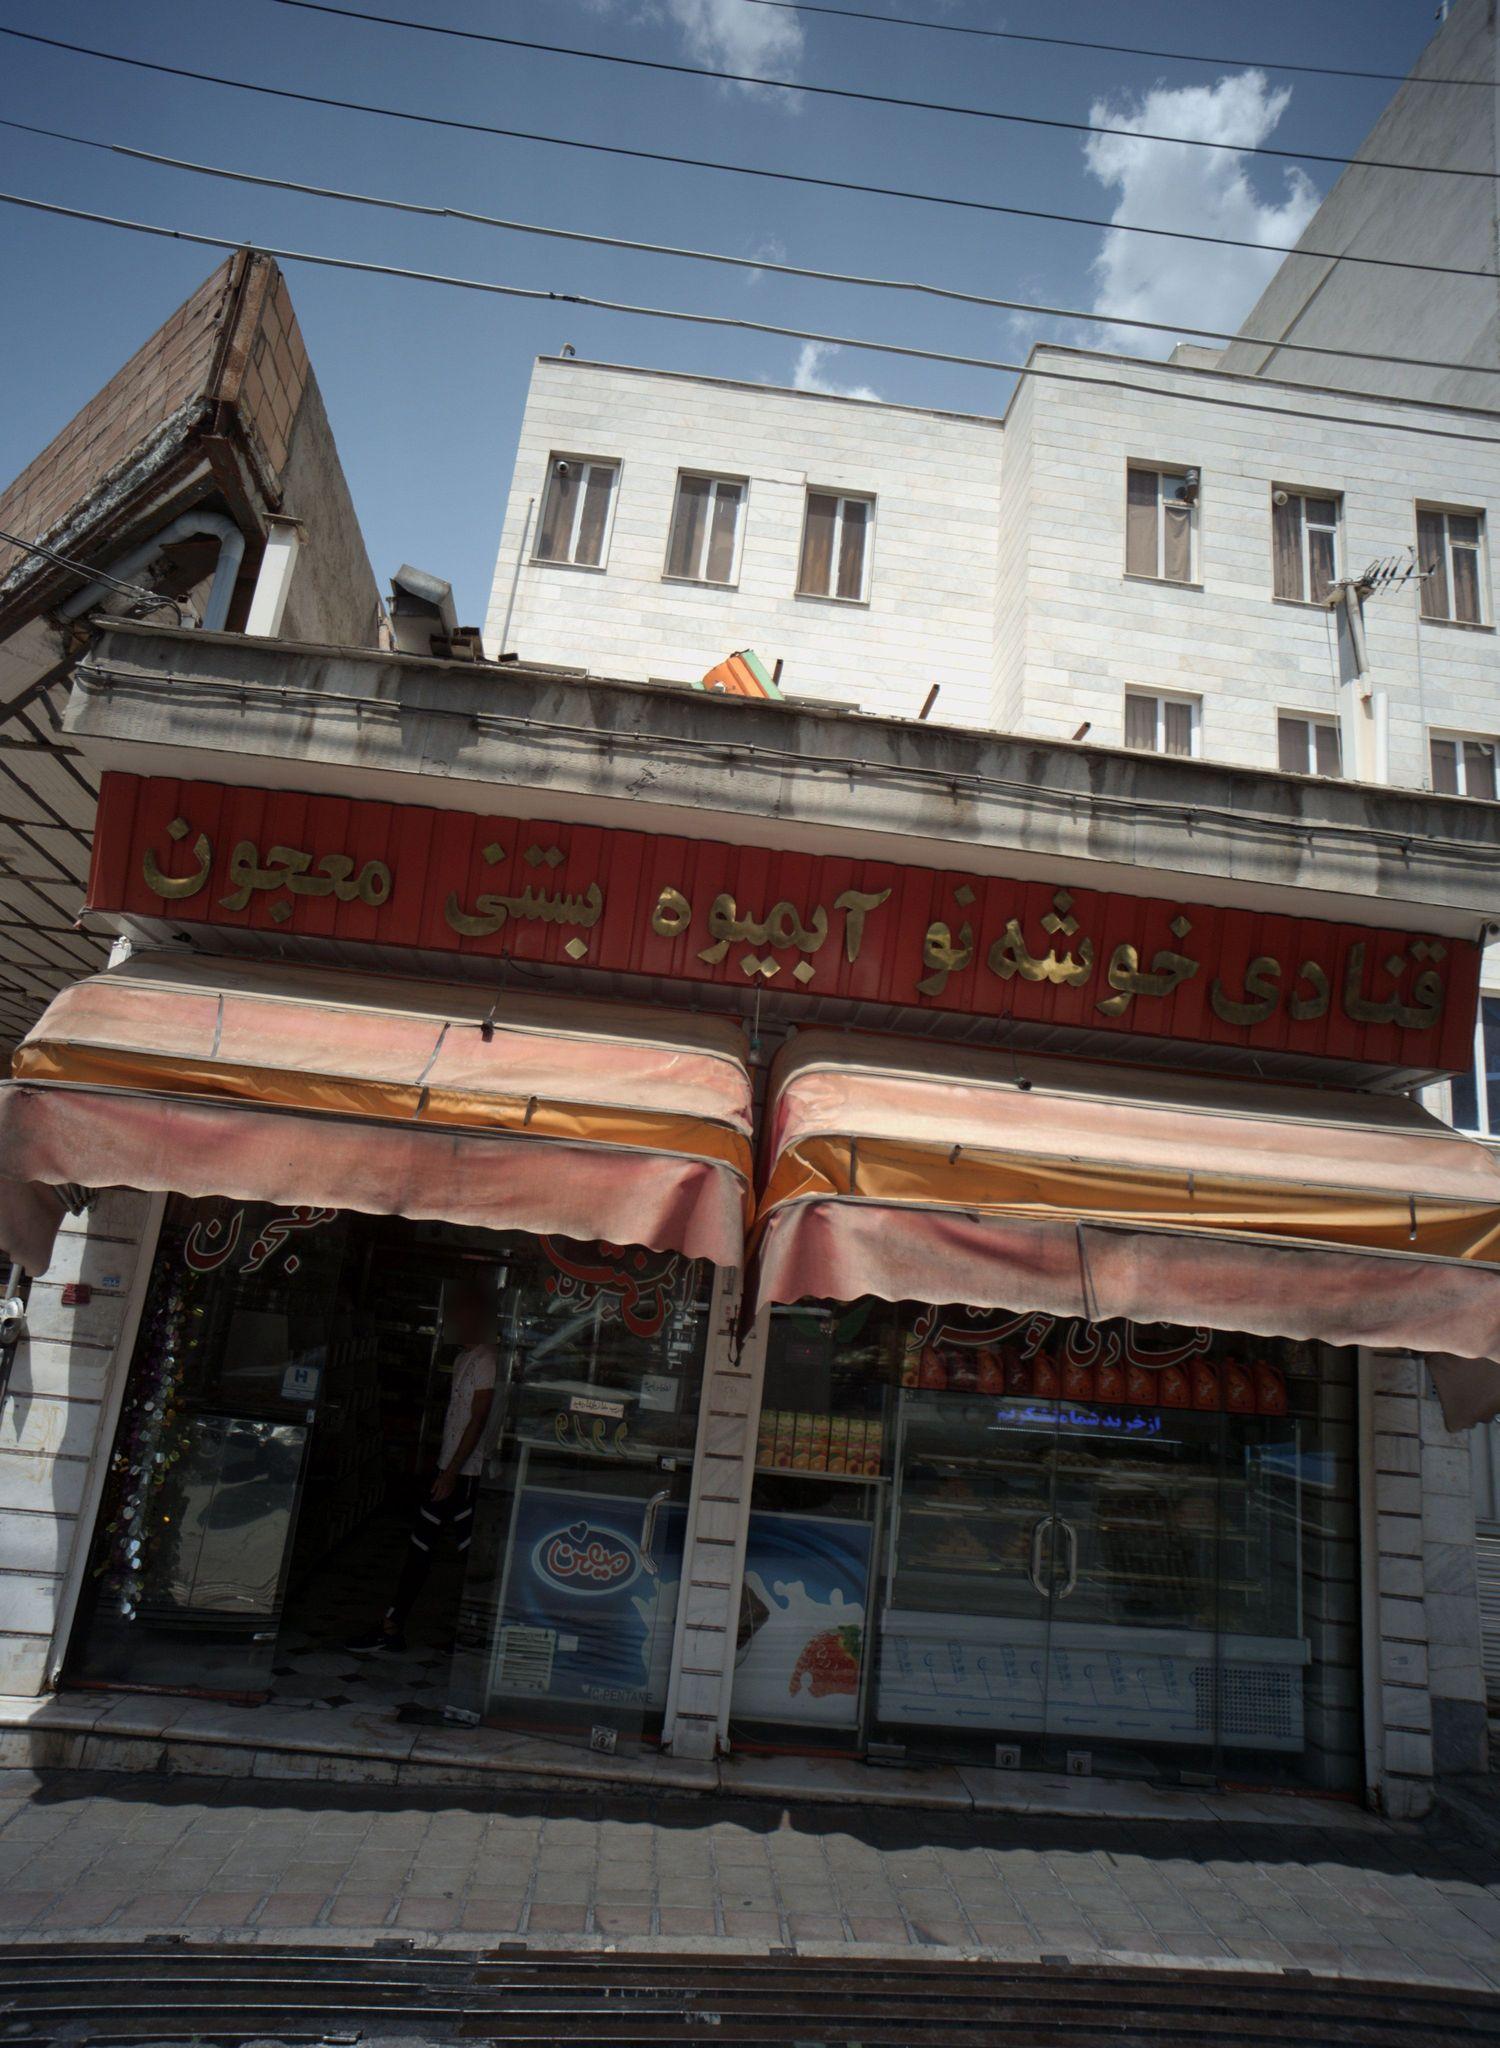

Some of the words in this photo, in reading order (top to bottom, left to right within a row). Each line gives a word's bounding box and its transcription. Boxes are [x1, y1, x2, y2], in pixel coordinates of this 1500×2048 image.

[143, 816, 392, 924] معجون
[444, 841, 604, 961] بستنی
[652, 886, 892, 984] آبمیوه
[915, 884, 976, 997] نو
[986, 889, 1200, 1017] خوشه
[1210, 939, 1449, 1030] قنادی
[547, 1538, 630, 1580] میهن
